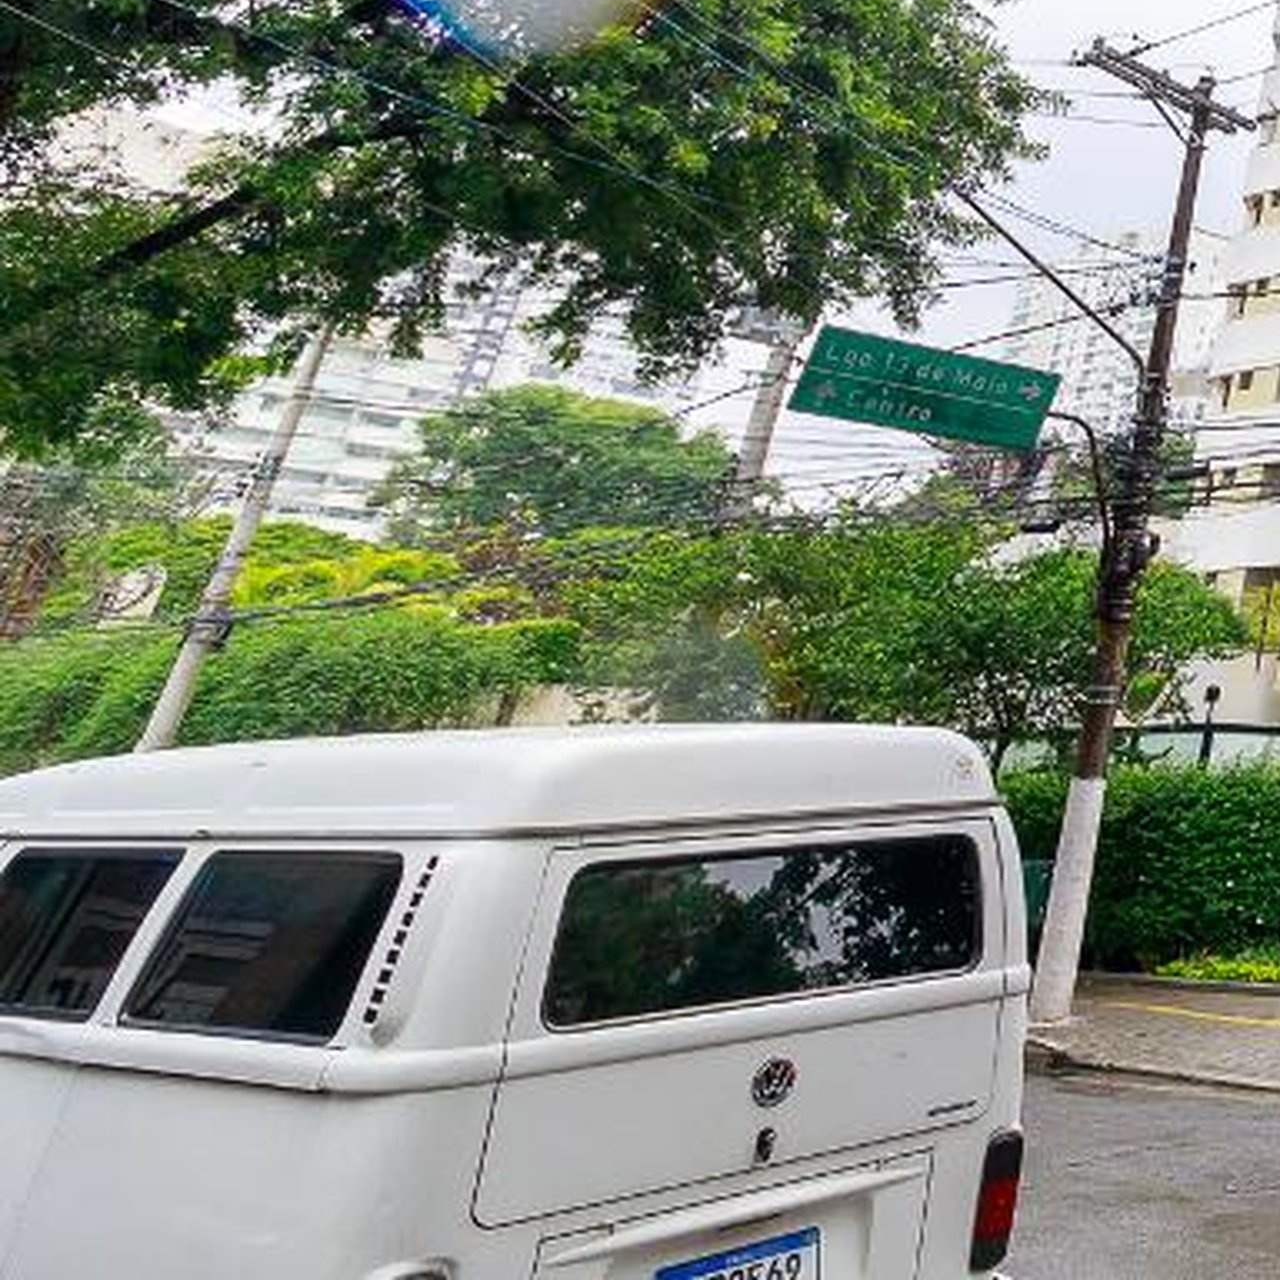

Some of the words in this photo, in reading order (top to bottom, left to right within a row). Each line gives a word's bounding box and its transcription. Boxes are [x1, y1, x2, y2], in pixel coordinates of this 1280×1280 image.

[825, 345, 872, 371] Lgo
[915, 364, 945, 381] de
[954, 367, 1008, 394] Maio
[846, 388, 932, 421] Centro
